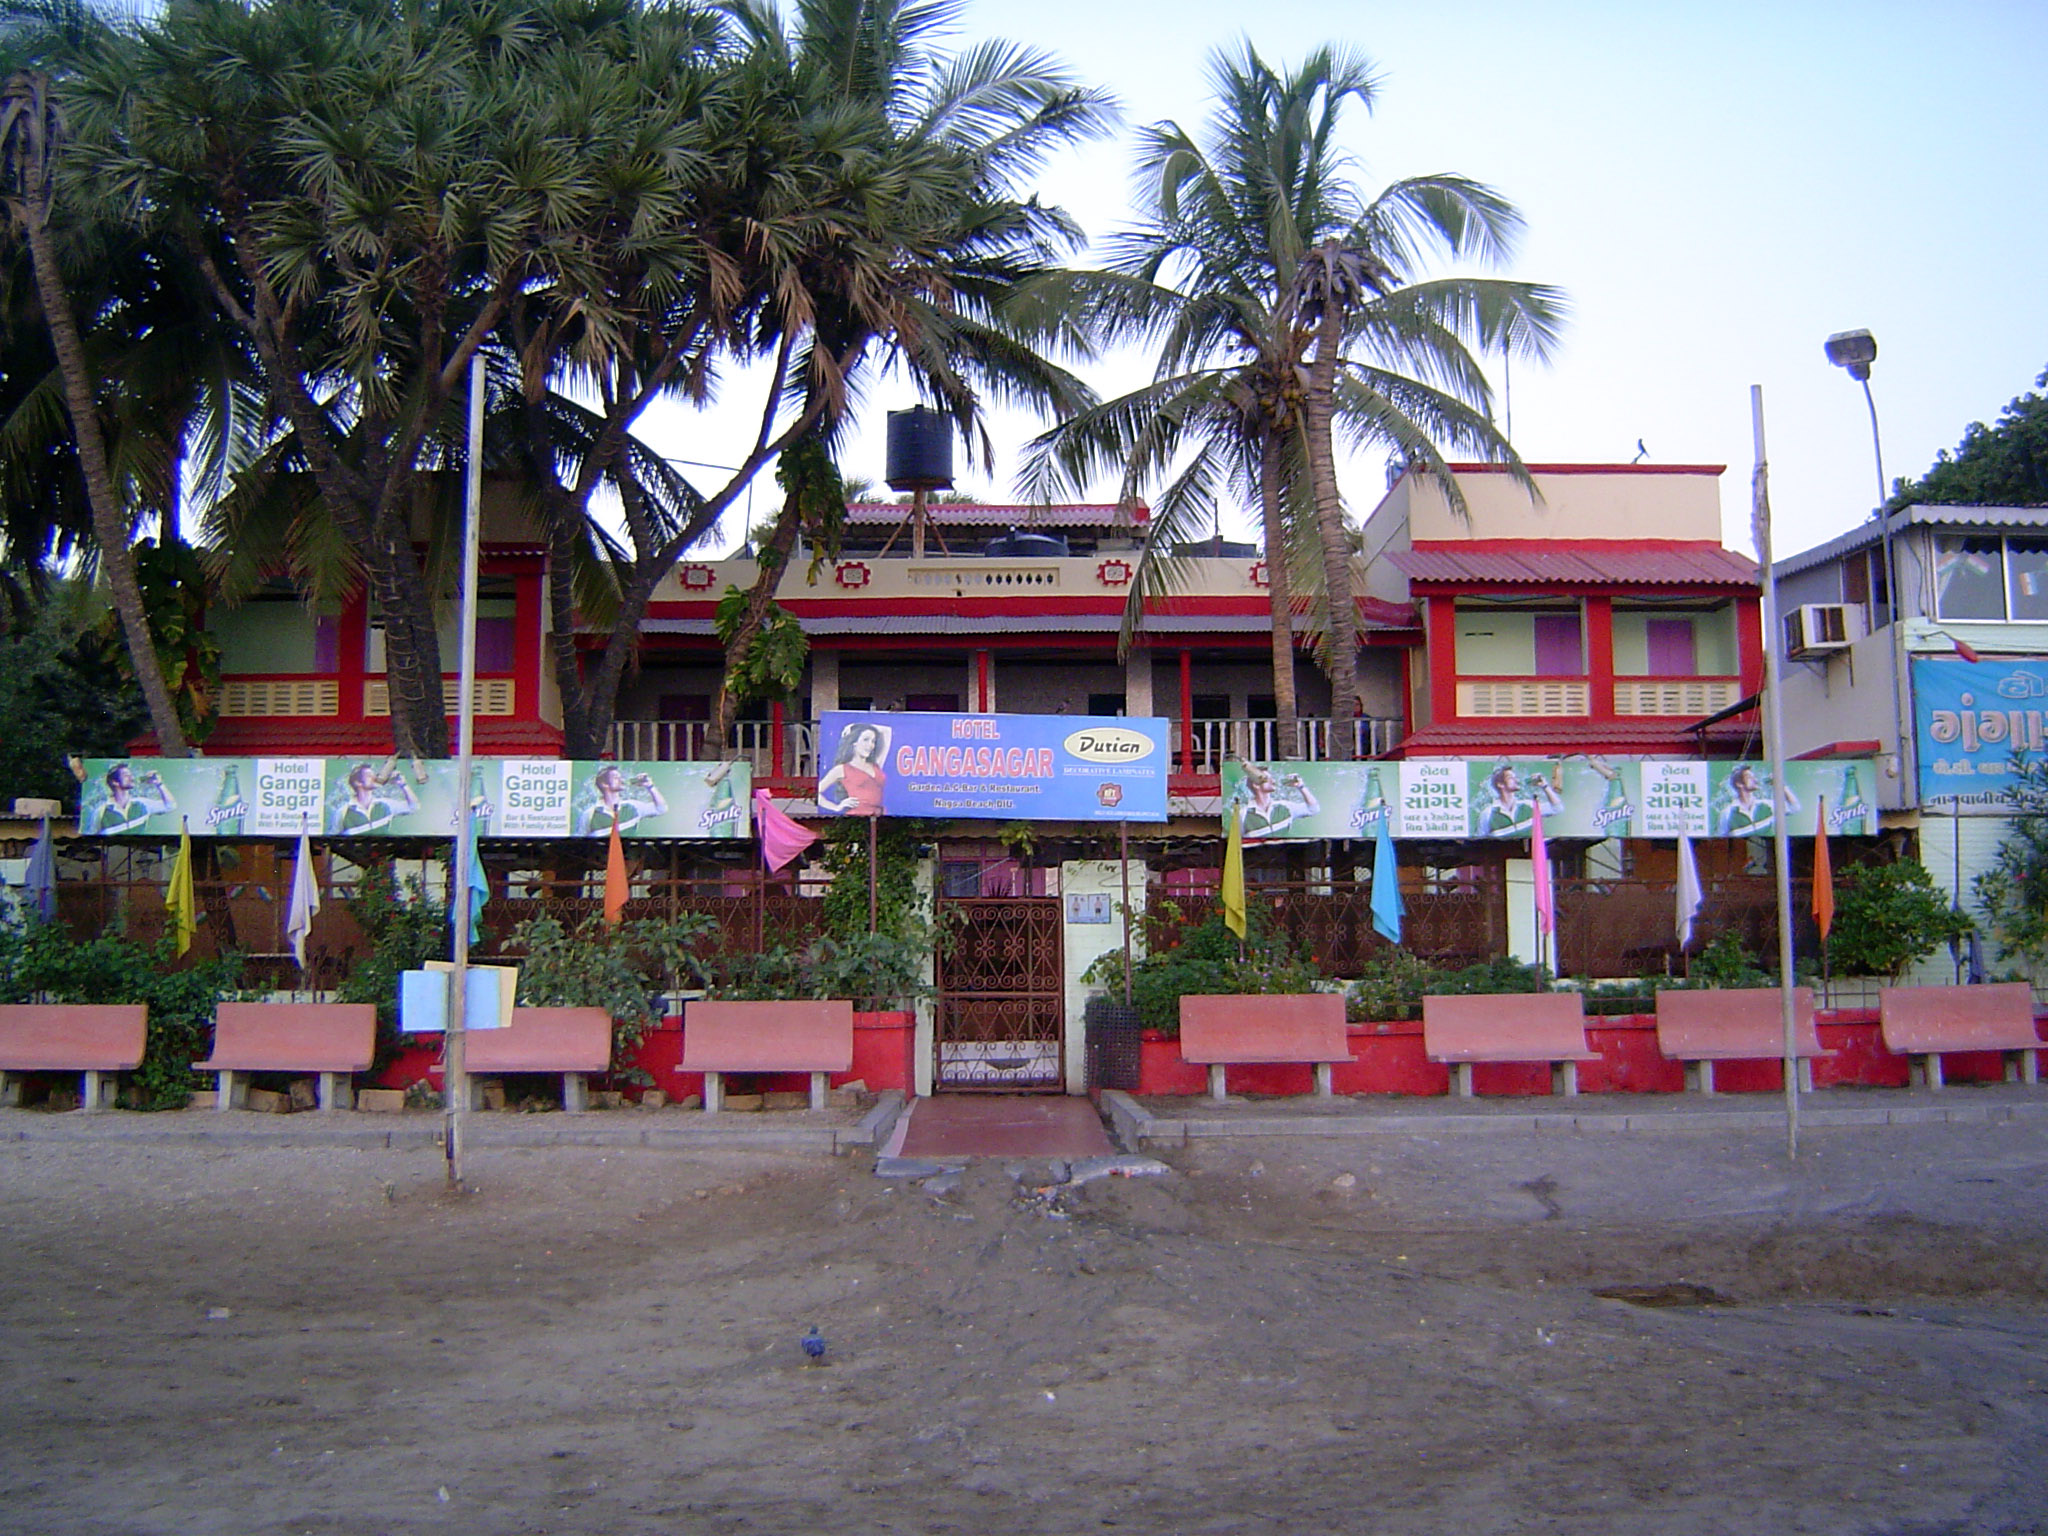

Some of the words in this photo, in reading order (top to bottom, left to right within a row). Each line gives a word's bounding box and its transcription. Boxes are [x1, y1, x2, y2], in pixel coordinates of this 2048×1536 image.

[1997, 670, 2048, 699] હો
[952, 719, 1000, 739] HOTEL
[1930, 692, 2048, 752] ગંગા
[1079, 736, 1140, 753] Durian
[274, 762, 309, 774] Hotel
[521, 764, 556, 775] Hotel
[896, 745, 1054, 778] GANGASAGAR
[1063, 767, 1112, 775] DECORATIVE
[1420, 764, 1449, 776] હોટલ
[1661, 764, 1690, 775] હોટલ
[259, 774, 321, 794] Ganga
[505, 775, 569, 794] Ganga
[1410, 779, 1456, 795] ગંગા
[1651, 778, 1696, 794] ગંગા
[261, 791, 319, 810] Sagar
[508, 792, 566, 811] Sagar
[1404, 796, 1463, 809] સાગર
[1646, 795, 1703, 808] સાગર
[205, 801, 249, 827] Sprite
[699, 804, 743, 831] Sprite
[1351, 805, 1393, 829] Sprie
[1593, 804, 1635, 828] Sprite
[1829, 803, 1869, 825] Sprite
